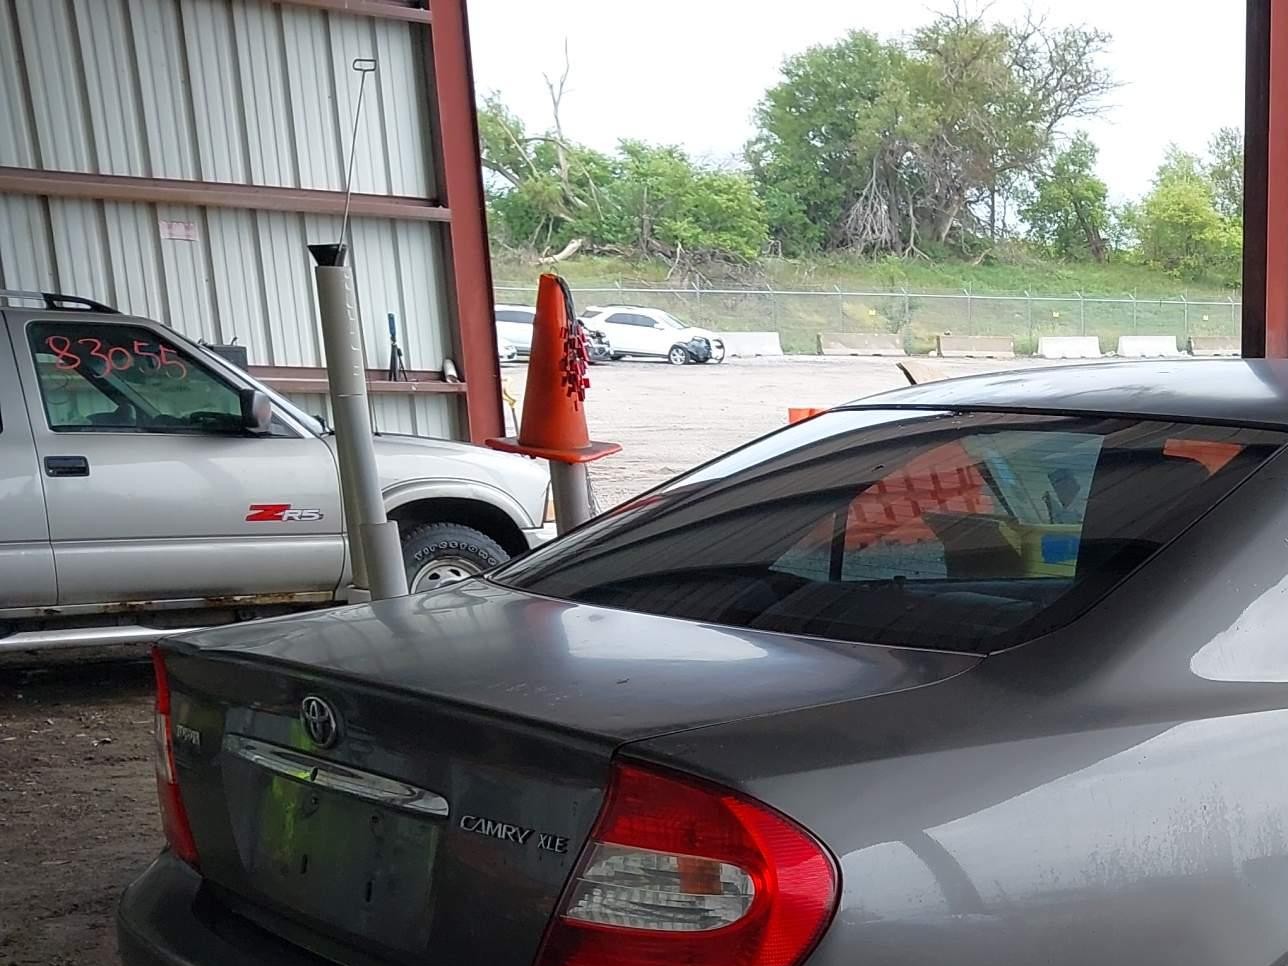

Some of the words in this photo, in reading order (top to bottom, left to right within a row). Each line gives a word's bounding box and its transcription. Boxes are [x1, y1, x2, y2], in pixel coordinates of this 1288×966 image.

[45, 335, 187, 380] 83055
[245, 503, 324, 522] ZR5
[460, 815, 531, 844] CAMRY
[537, 833, 568, 853] XLE
